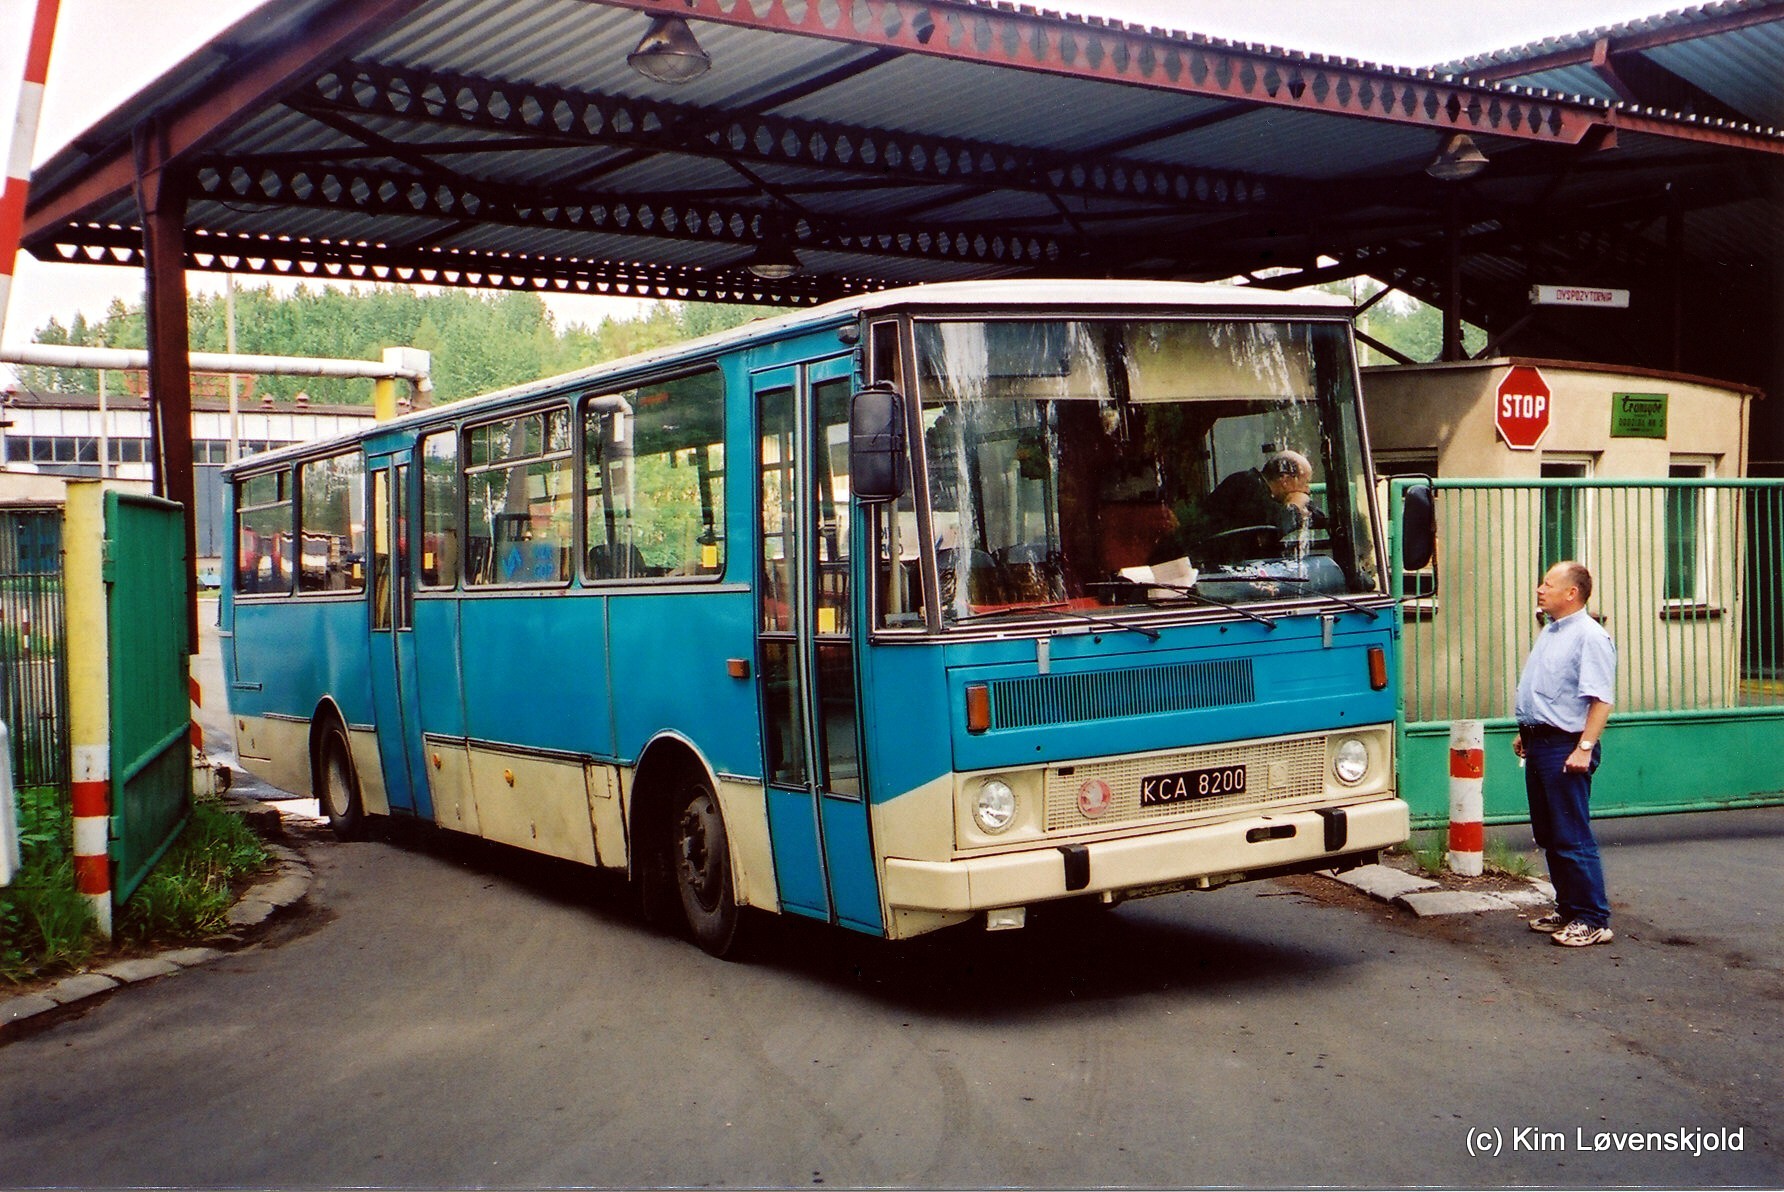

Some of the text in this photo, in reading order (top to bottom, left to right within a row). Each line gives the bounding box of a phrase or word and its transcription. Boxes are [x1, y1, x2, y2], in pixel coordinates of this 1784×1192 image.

[1502, 393, 1546, 419] STOP
[1143, 768, 1244, 803] KCA 8200
